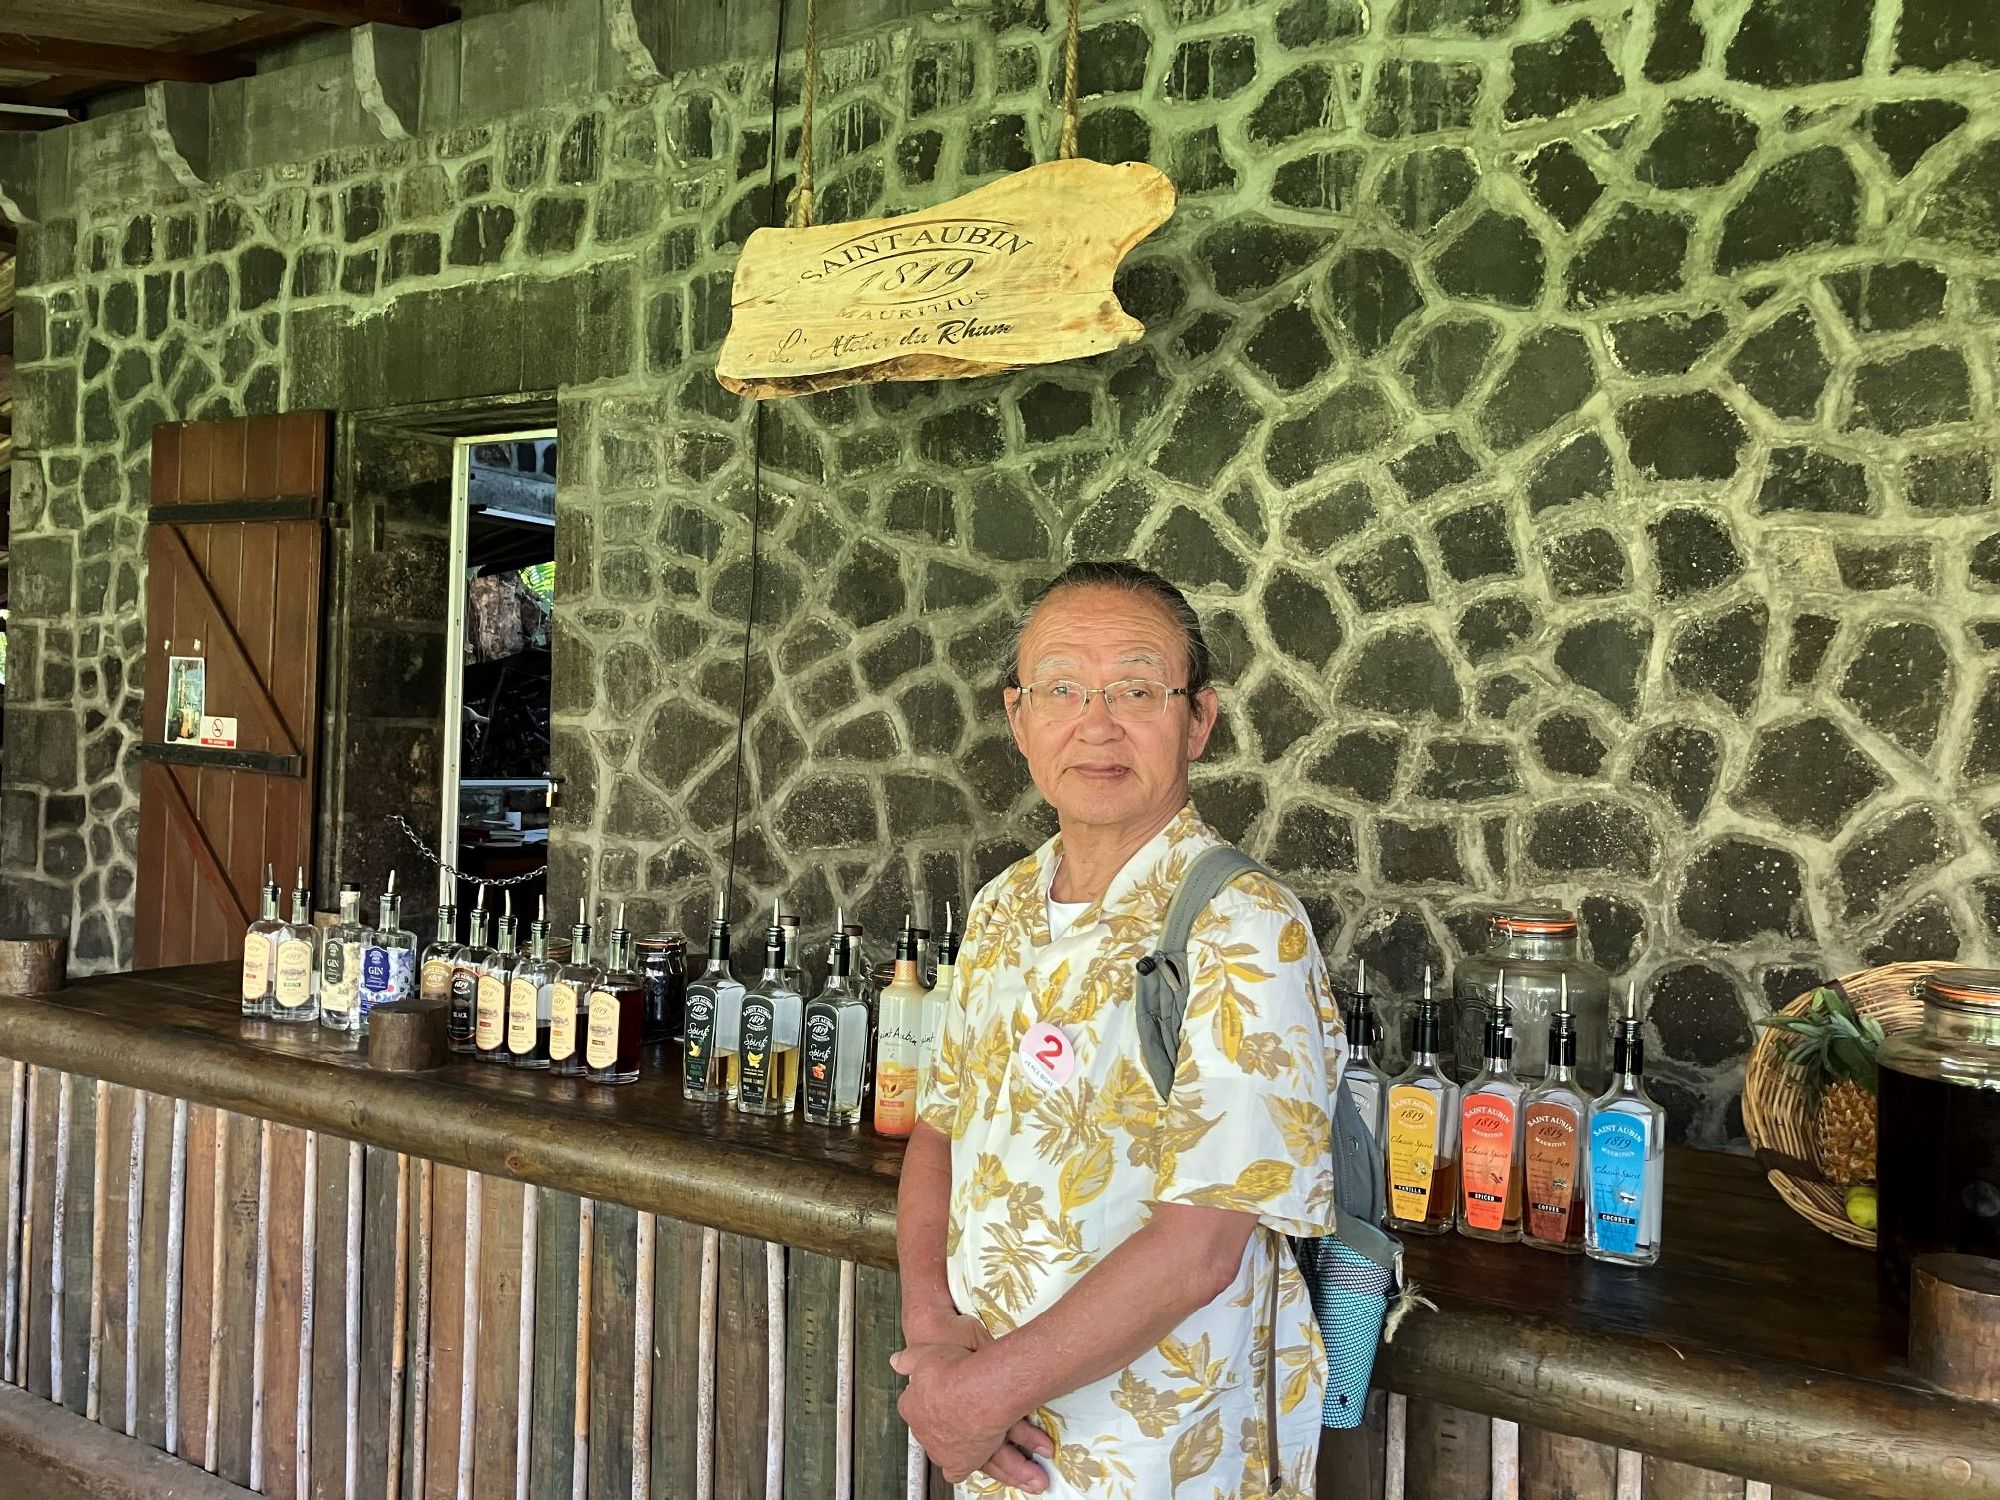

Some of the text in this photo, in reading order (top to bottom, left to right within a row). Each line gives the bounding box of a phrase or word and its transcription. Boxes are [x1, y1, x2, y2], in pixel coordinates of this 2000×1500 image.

[800, 226, 1034, 282] SAINT AUBIN
[852, 257, 974, 294] 1819
[835, 288, 991, 320] MAURITIUS
[900, 327, 929, 346] du
[936, 318, 1014, 345] Rhum
[326, 958, 340, 968] GIN
[368, 966, 384, 976] GIN
[692, 1004, 708, 1013] 1819
[748, 1015, 765, 1026] 1819
[812, 1025, 829, 1036] 1819
[1036, 1035, 1062, 1070] 2
[1400, 1109, 1424, 1122] 1819
[1464, 1106, 1511, 1124] SAINT AUBIN
[1475, 1117, 1500, 1130] 1819
[1527, 1115, 1574, 1134] SAINT AUBIN
[1539, 1126, 1562, 1139] 1819
[1593, 1125, 1643, 1143] SAINT AUBIN
[1605, 1136, 1632, 1149] 1819
[1474, 1193, 1495, 1202] SPICED
[1602, 1214, 1630, 1224] COCONUT
